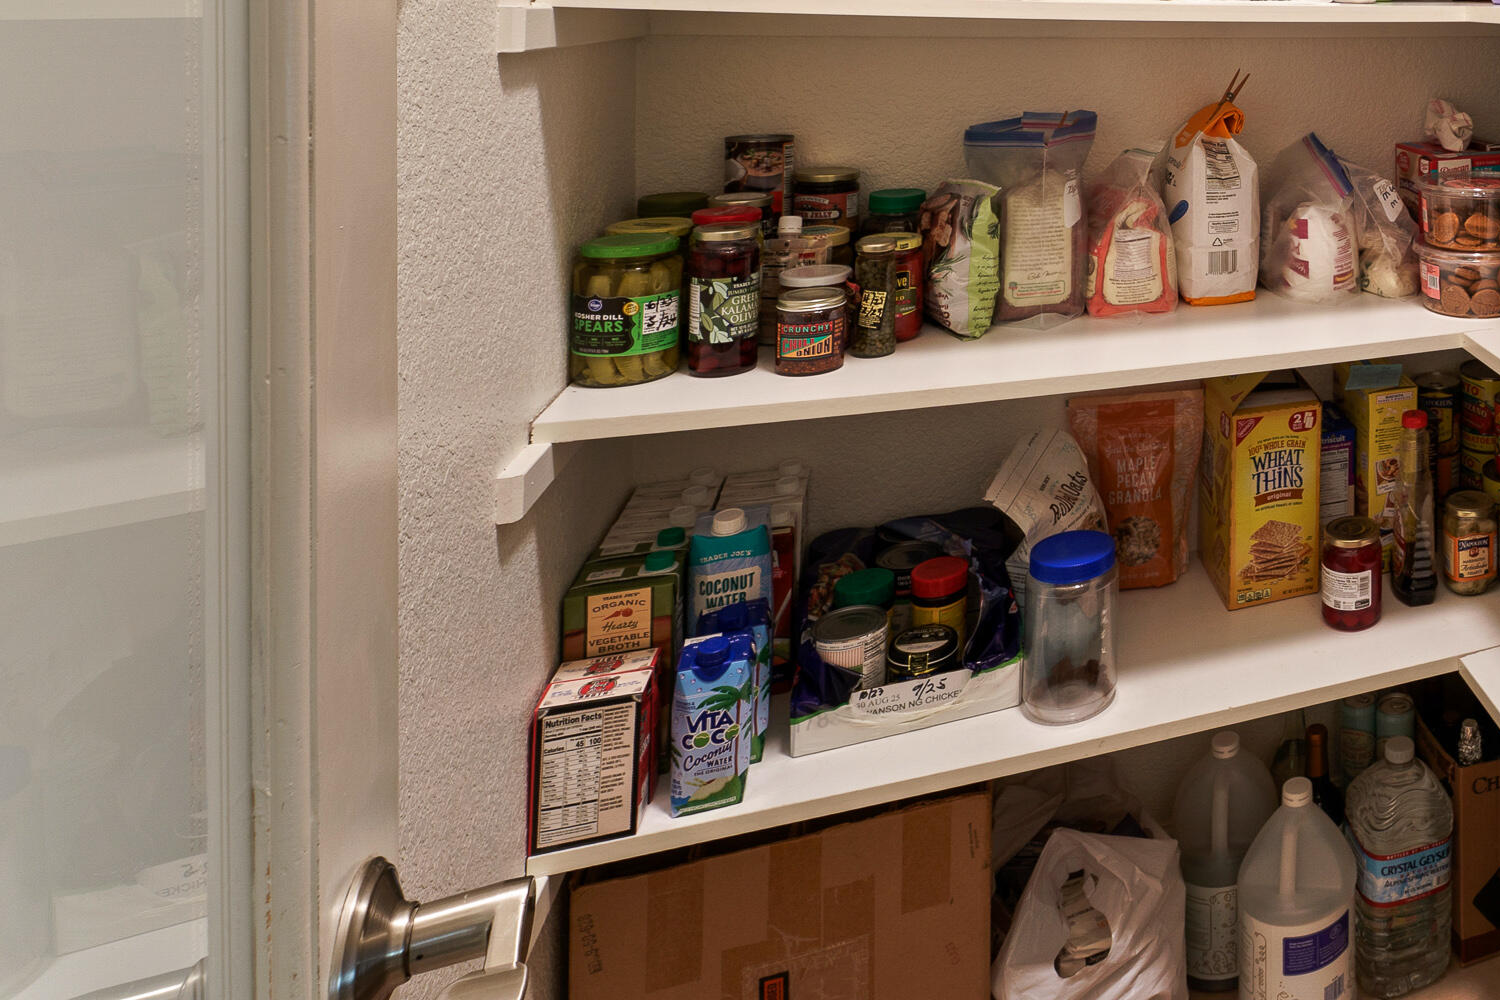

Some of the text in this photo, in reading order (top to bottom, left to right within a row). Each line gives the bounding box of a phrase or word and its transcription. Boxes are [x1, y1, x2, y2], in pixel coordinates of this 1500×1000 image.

[574, 311, 601, 320] KOSHER
[574, 320, 624, 333] SPEARS
[783, 323, 830, 333] CRUNCHY
[796, 338, 831, 357] ONION
[1293, 413, 1302, 424] 2
[1116, 455, 1156, 473] MAPLE
[1250, 449, 1304, 471] WHEAT
[1117, 471, 1156, 488] PECAN
[1108, 487, 1162, 505] GRANOLA
[1266, 491, 1292, 501] original
[1458, 537, 1489, 551] NAPOLEON
[700, 572, 756, 597] COCONUT
[592, 599, 647, 614] ORGANIC
[601, 619, 639, 633] Hearty
[588, 631, 650, 647] VEGETABLE
[598, 640, 641, 654] BROTH
[867, 696, 889, 708] AUG
[545, 712, 602, 729] Nutrition Facts
[686, 710, 735, 734] VITA
[575, 737, 602, 748] 45 100
[682, 724, 740, 751] COCO
[543, 746, 565, 755] Calories
[683, 740, 734, 772] Coconut
[706, 756, 734, 768] WATER
